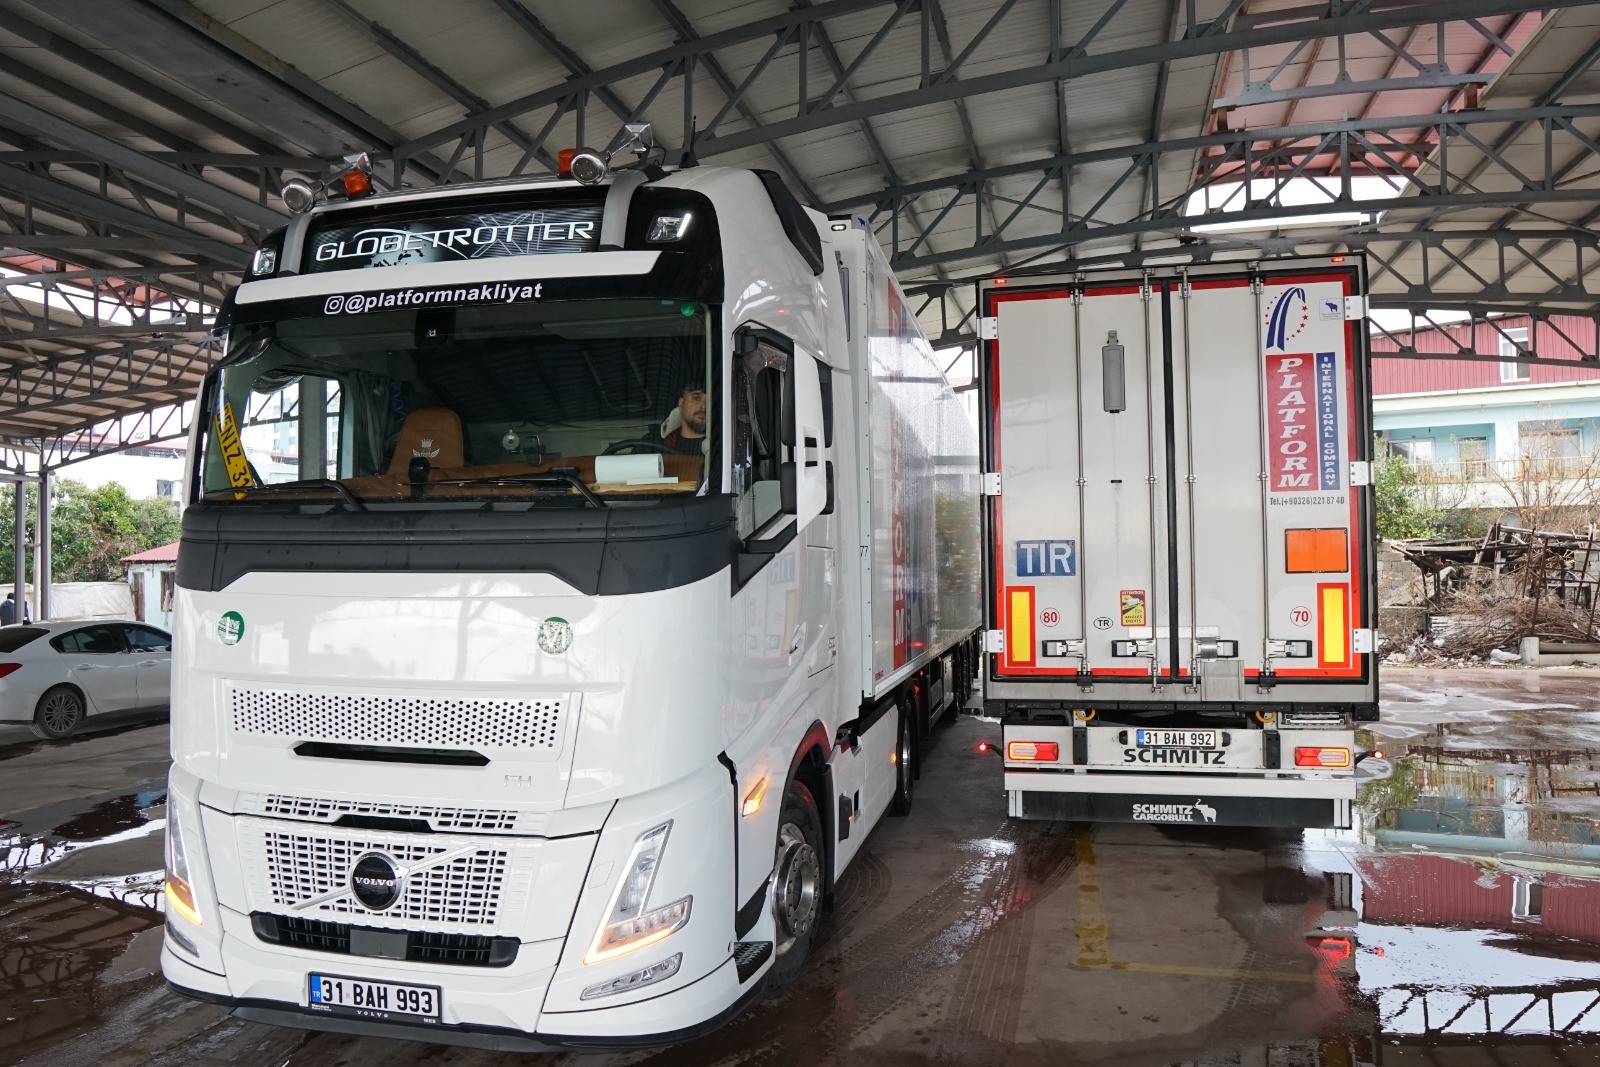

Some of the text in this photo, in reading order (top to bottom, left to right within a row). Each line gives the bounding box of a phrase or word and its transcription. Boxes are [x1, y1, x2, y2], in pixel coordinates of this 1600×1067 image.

[315, 221, 594, 262] GLOBETROTTER
[345, 283, 542, 314] @platformnakliyat
[1277, 357, 1313, 488] PLATFORM
[1321, 356, 1336, 486] INTERNATIONAL COMPANY
[1336, 496, 1345, 505] 40
[1020, 542, 1072, 574] TIR
[1043, 611, 1057, 623] 80
[1293, 611, 1309, 622] 70
[1097, 619, 1110, 627] TR
[1145, 732, 1212, 746] 31 BAH 992
[1123, 748, 1226, 764] SCHMITZ
[503, 775, 532, 788] FH
[1132, 803, 1194, 814] SCHMITZ
[1132, 813, 1194, 822] CARGOBULL
[354, 876, 394, 887] VOLVO
[312, 990, 321, 998] TR
[322, 980, 433, 1014] 31 BAH 993
[356, 1010, 389, 1018] VOLVO
